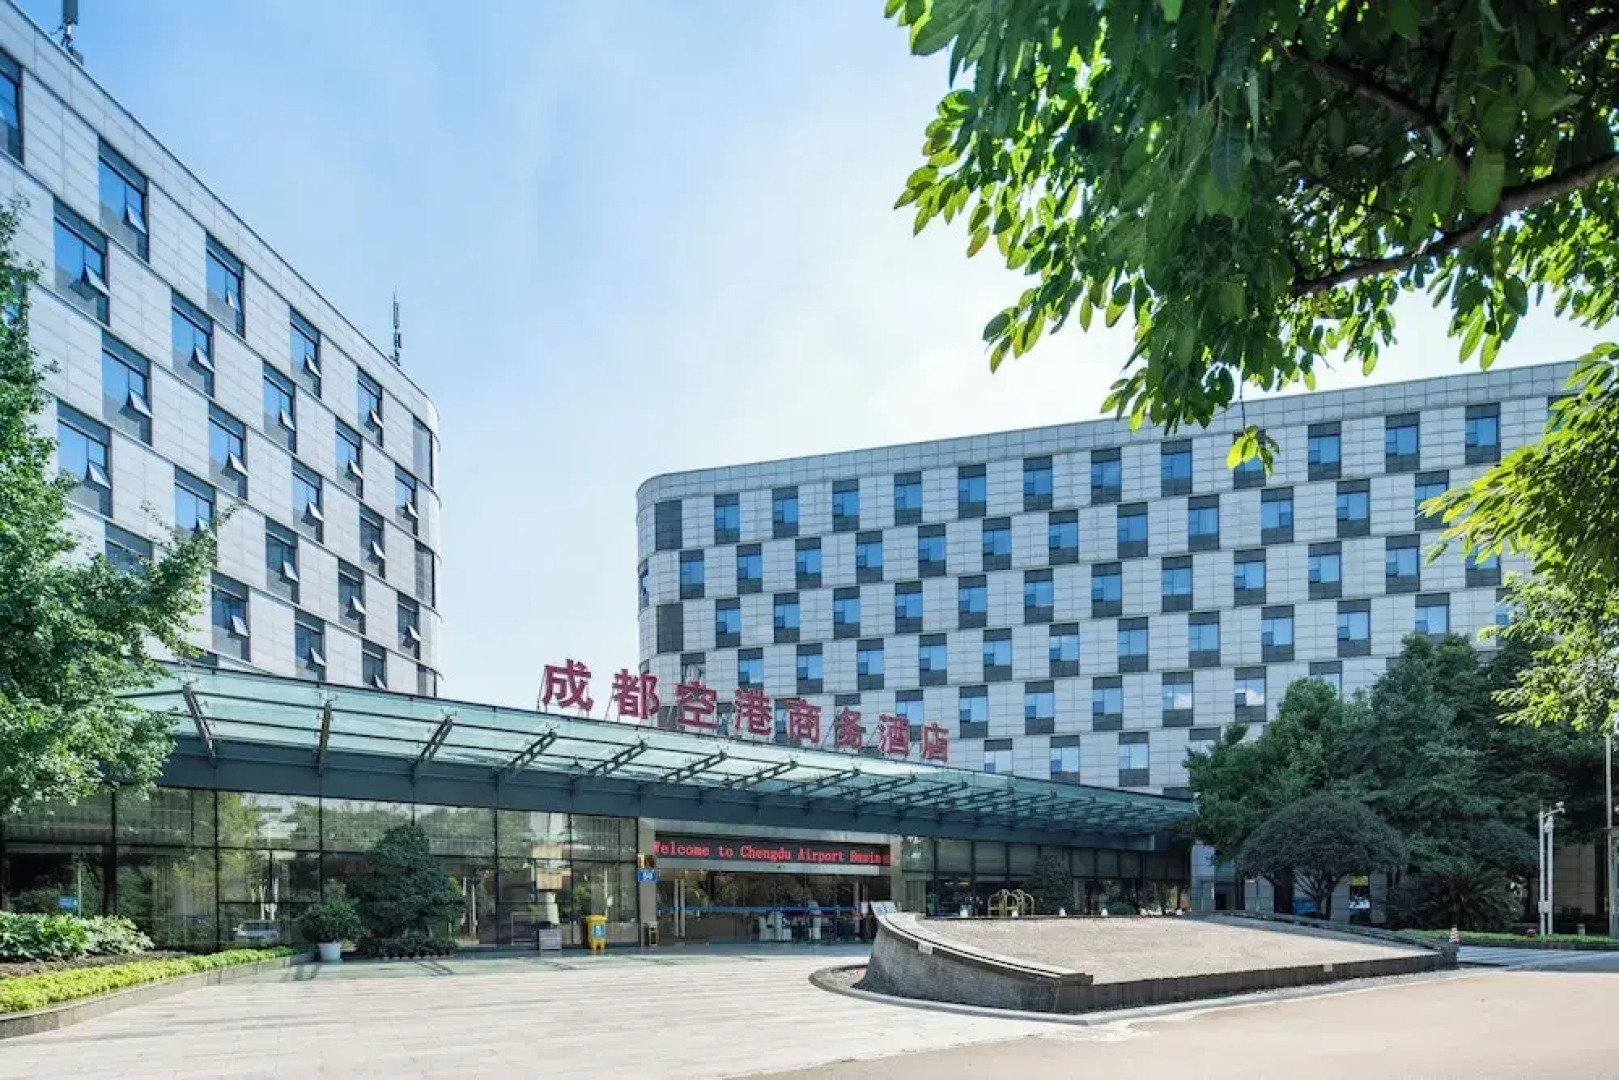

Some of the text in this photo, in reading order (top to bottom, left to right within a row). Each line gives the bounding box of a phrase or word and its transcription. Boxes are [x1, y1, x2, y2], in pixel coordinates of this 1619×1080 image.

[543, 659, 950, 762] 成都空港商务酒店
[653, 841, 710, 856] Welcome
[718, 845, 734, 857] to
[740, 845, 791, 862] Chengdu
[797, 847, 844, 863] Airport
